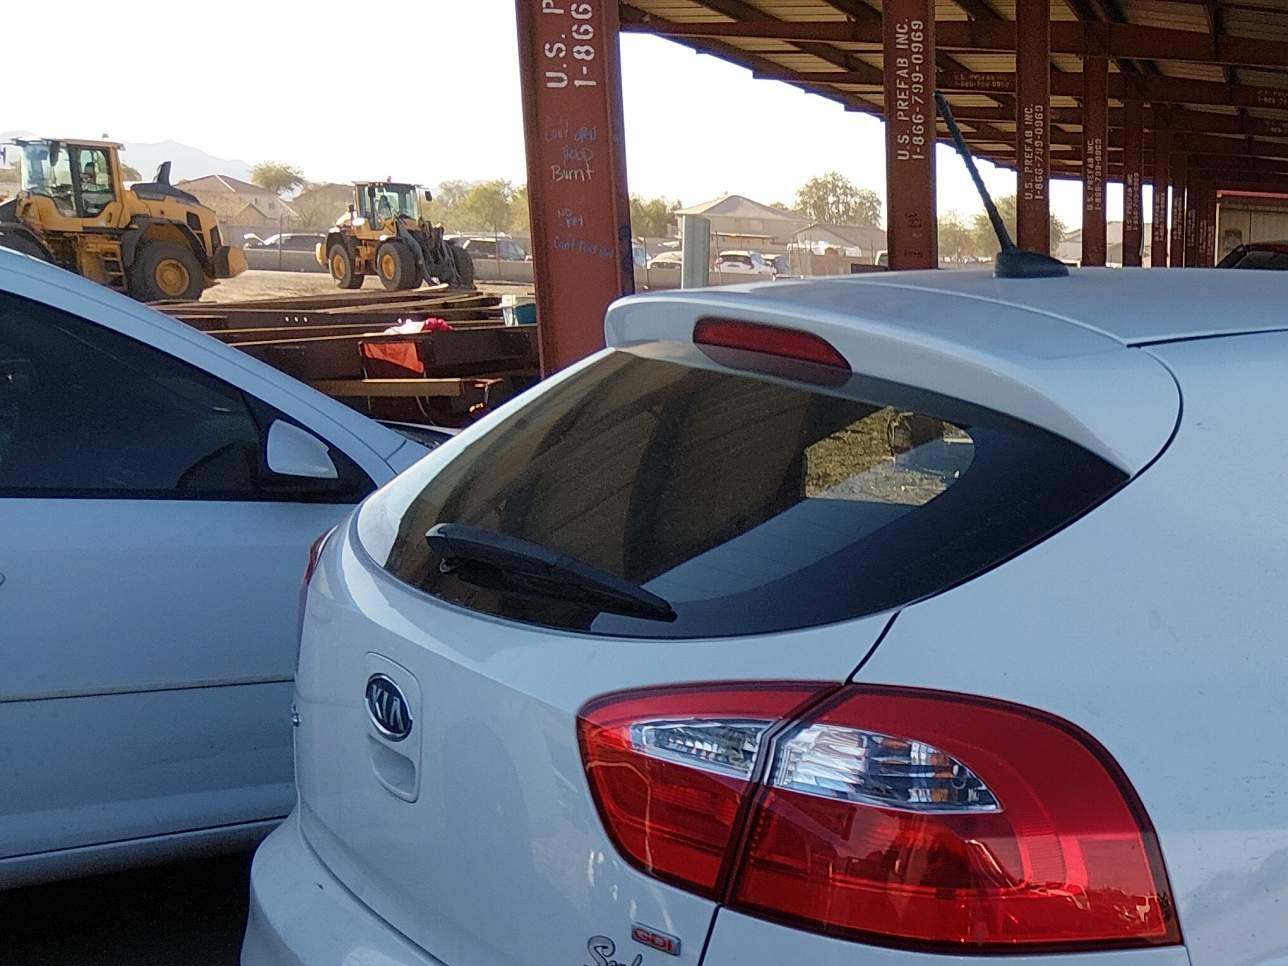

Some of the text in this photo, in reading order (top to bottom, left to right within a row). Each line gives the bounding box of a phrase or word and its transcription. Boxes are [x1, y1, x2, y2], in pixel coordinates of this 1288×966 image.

[544, 33, 569, 88] U.S.
[570, 3, 597, 87] 1-866
[895, 18, 910, 160] U.S. PREFAB INC.
[911, 20, 925, 159] 1-866-799-0969
[551, 162, 595, 182] Burnt
[1024, 130, 1034, 173] PREFAB
[370, 681, 406, 733] KIA
